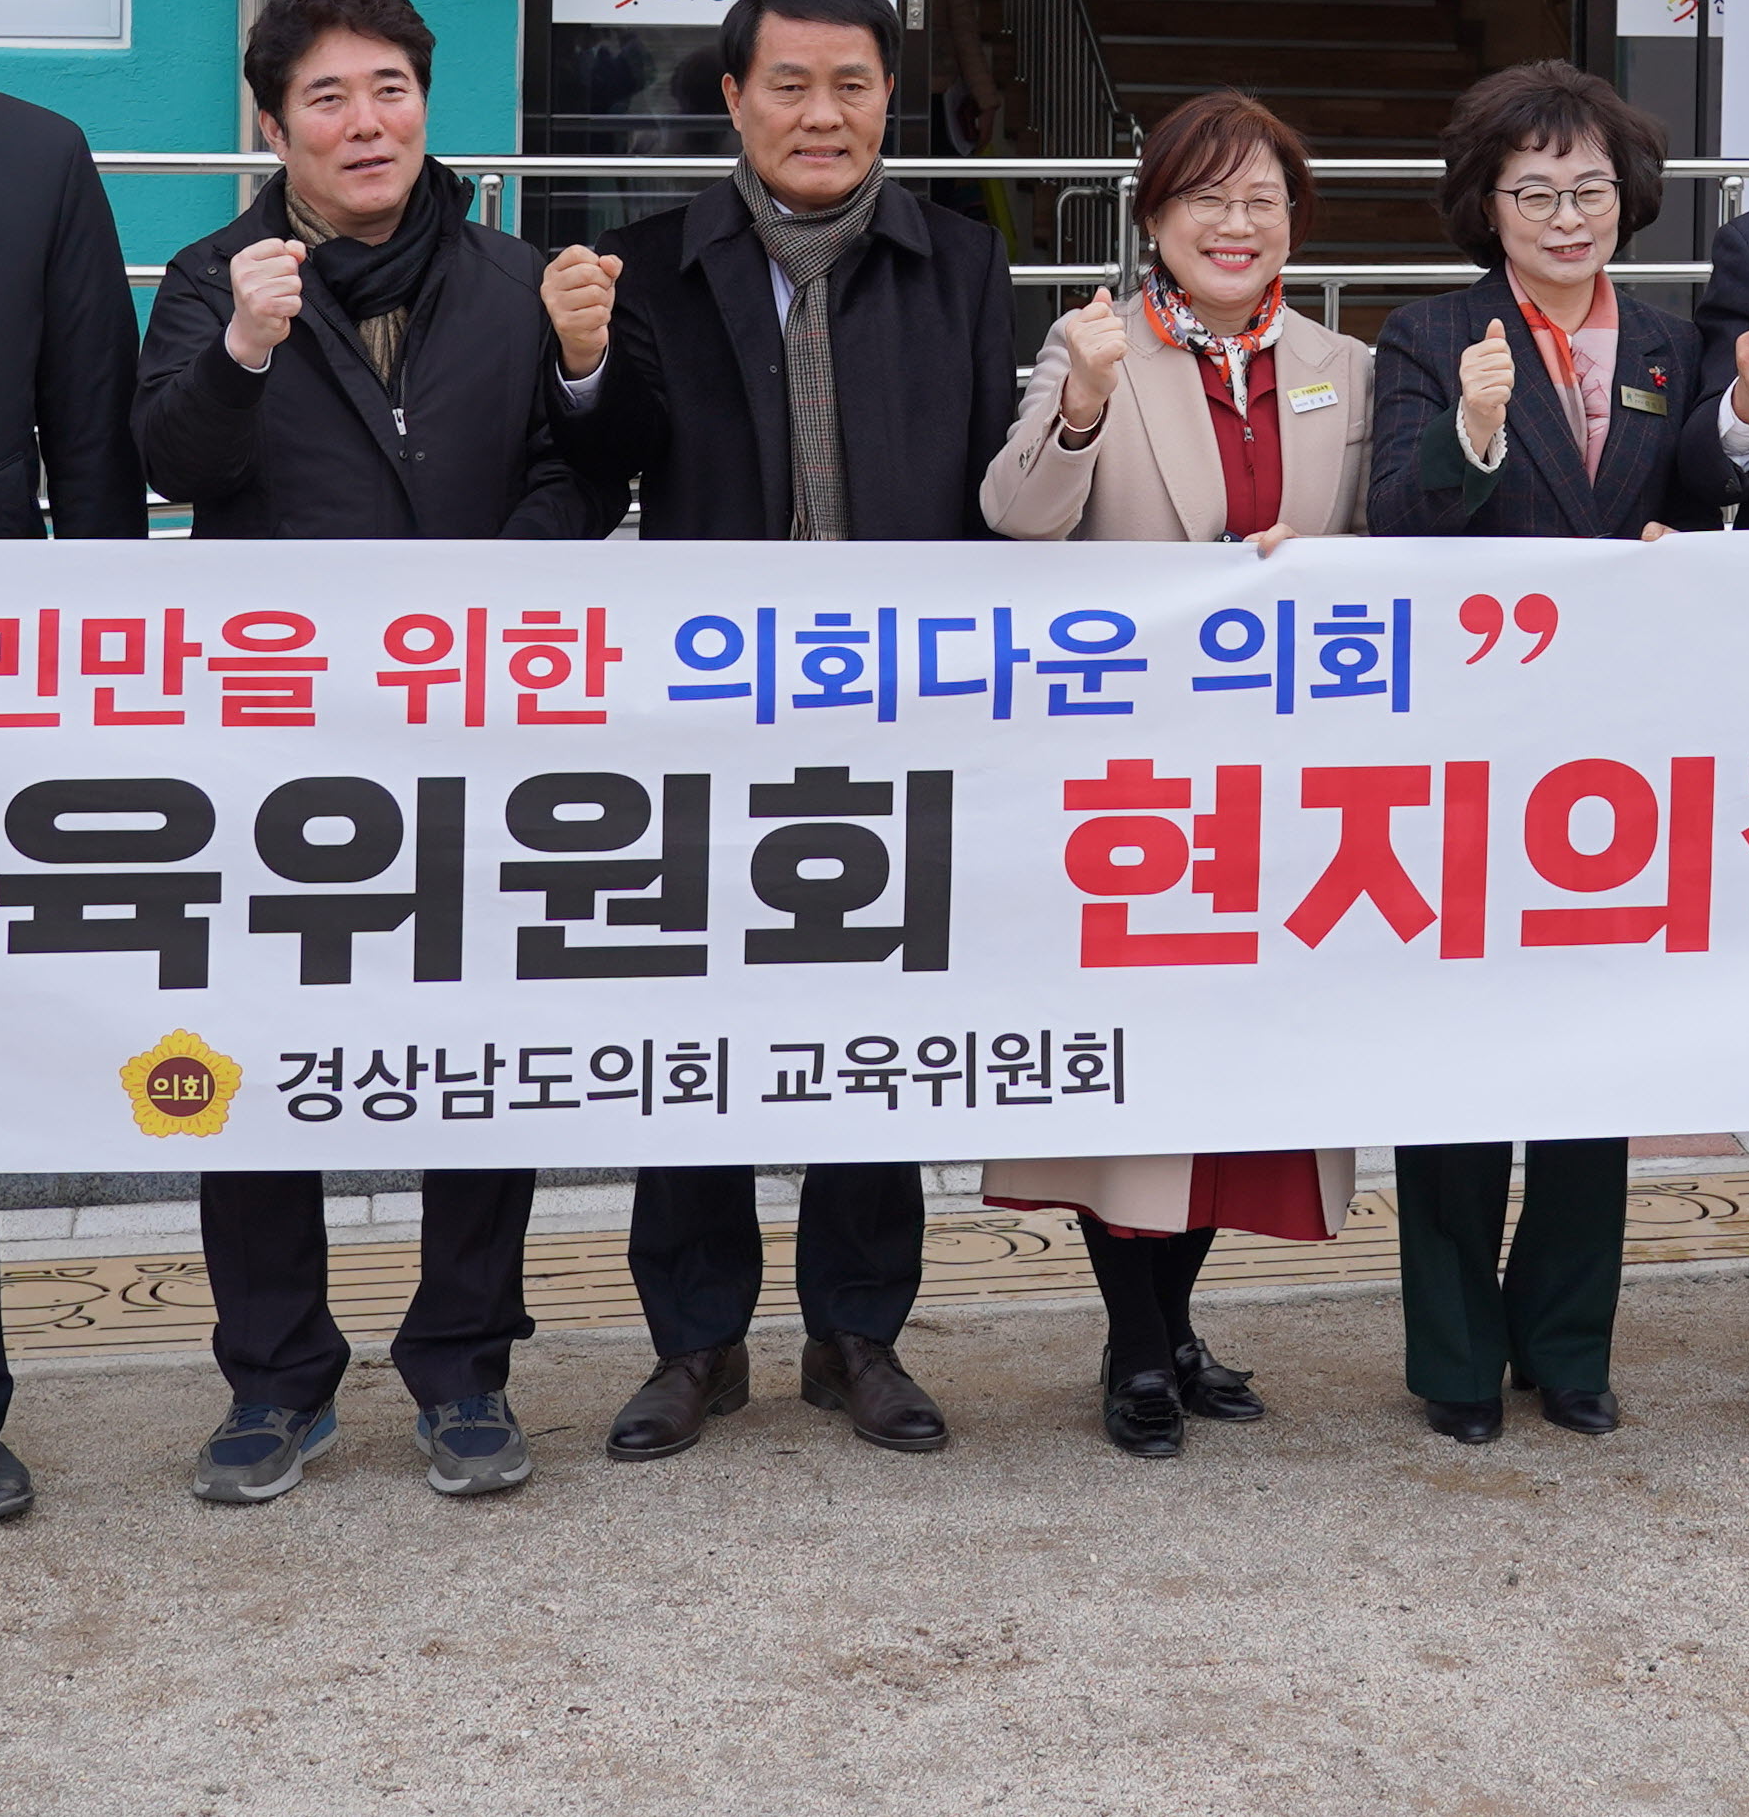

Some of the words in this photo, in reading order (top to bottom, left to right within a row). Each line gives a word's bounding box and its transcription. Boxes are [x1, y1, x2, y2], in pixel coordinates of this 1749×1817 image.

[376, 608, 623, 728] 위한
[667, 607, 1149, 725] 의회다운
[150, 1073, 209, 1101] 의회
[277, 1037, 728, 1122] 경상남도의회
[761, 1028, 1124, 1110] 교육위원회
